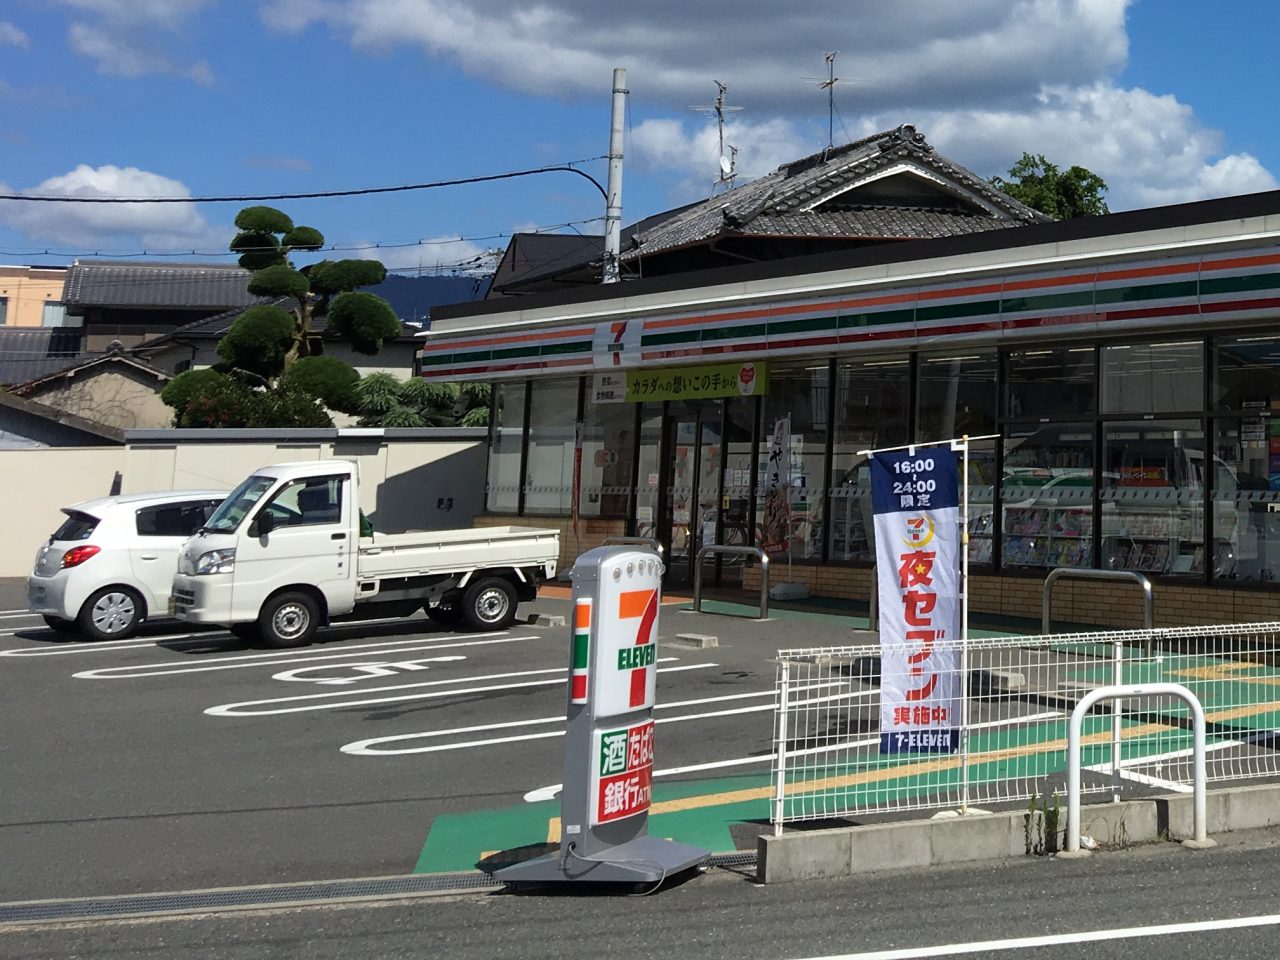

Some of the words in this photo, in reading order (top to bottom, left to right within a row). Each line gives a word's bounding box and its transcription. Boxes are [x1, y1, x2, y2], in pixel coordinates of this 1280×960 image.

[893, 458, 935, 474] 16:00
[893, 480, 936, 494] 24:00
[900, 494, 931, 508] 限定
[897, 550, 945, 702] 夜セブン
[602, 733, 627, 775] 酒
